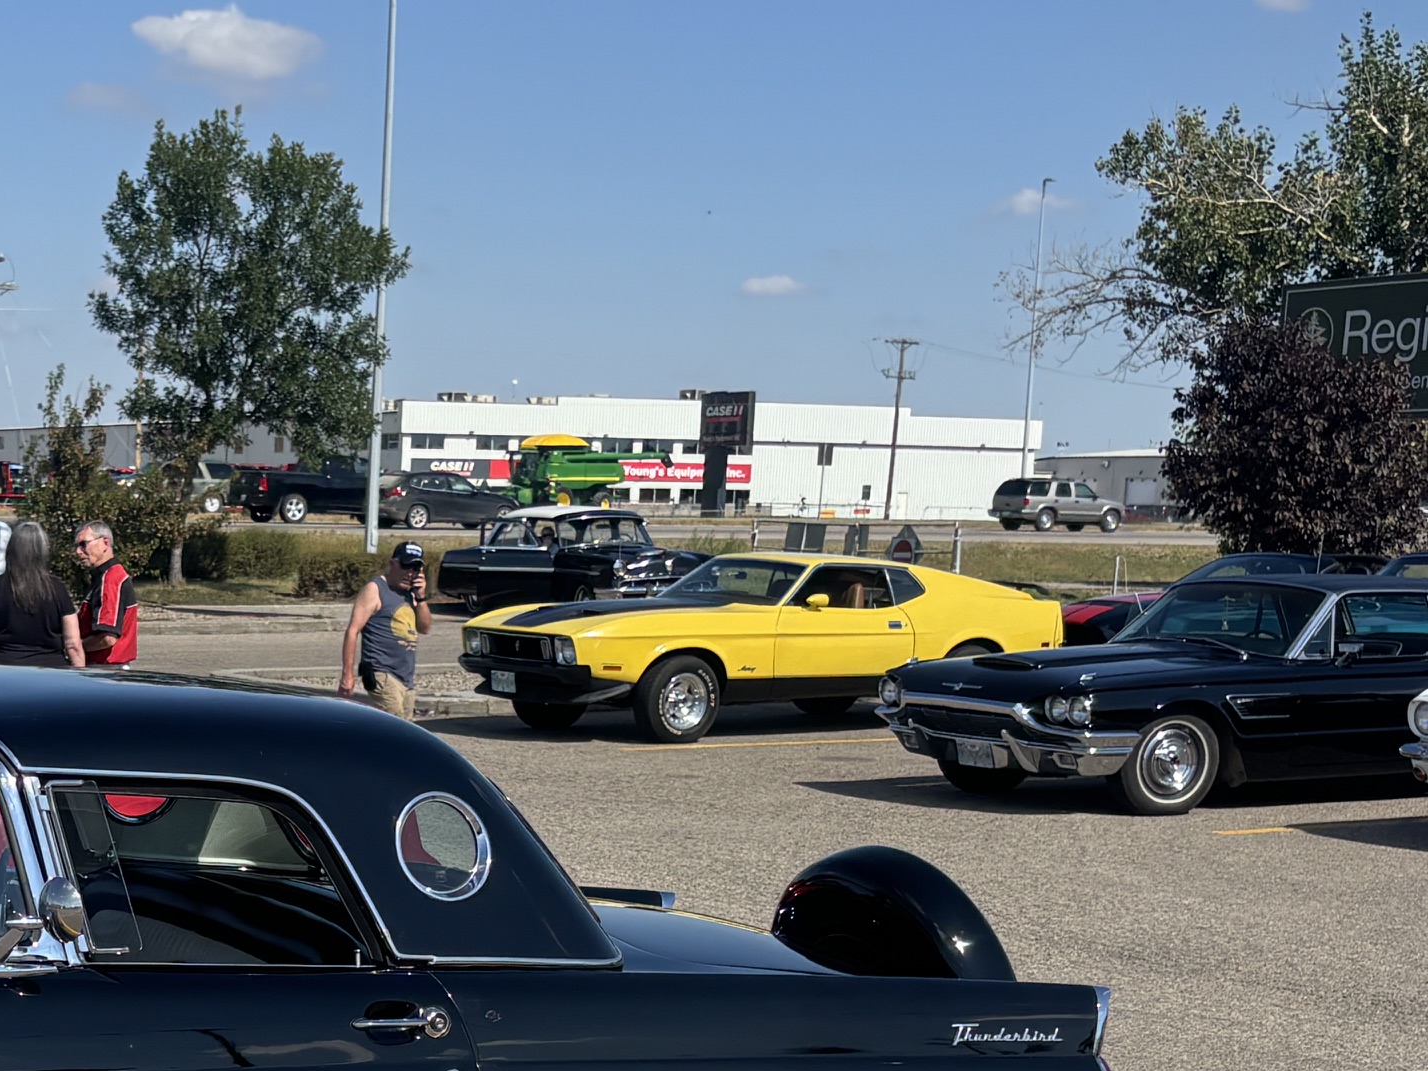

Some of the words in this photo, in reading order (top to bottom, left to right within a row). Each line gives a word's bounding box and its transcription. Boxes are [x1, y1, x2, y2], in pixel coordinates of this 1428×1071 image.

[1342, 305, 1428, 362] Regi
[706, 405, 733, 417] CASE
[430, 461, 463, 472] CASE
[623, 465, 665, 479] Young's
[666, 466, 704, 480] Equipm
[725, 466, 747, 479] Inc.
[951, 1023, 1064, 1046] Thunderbird
